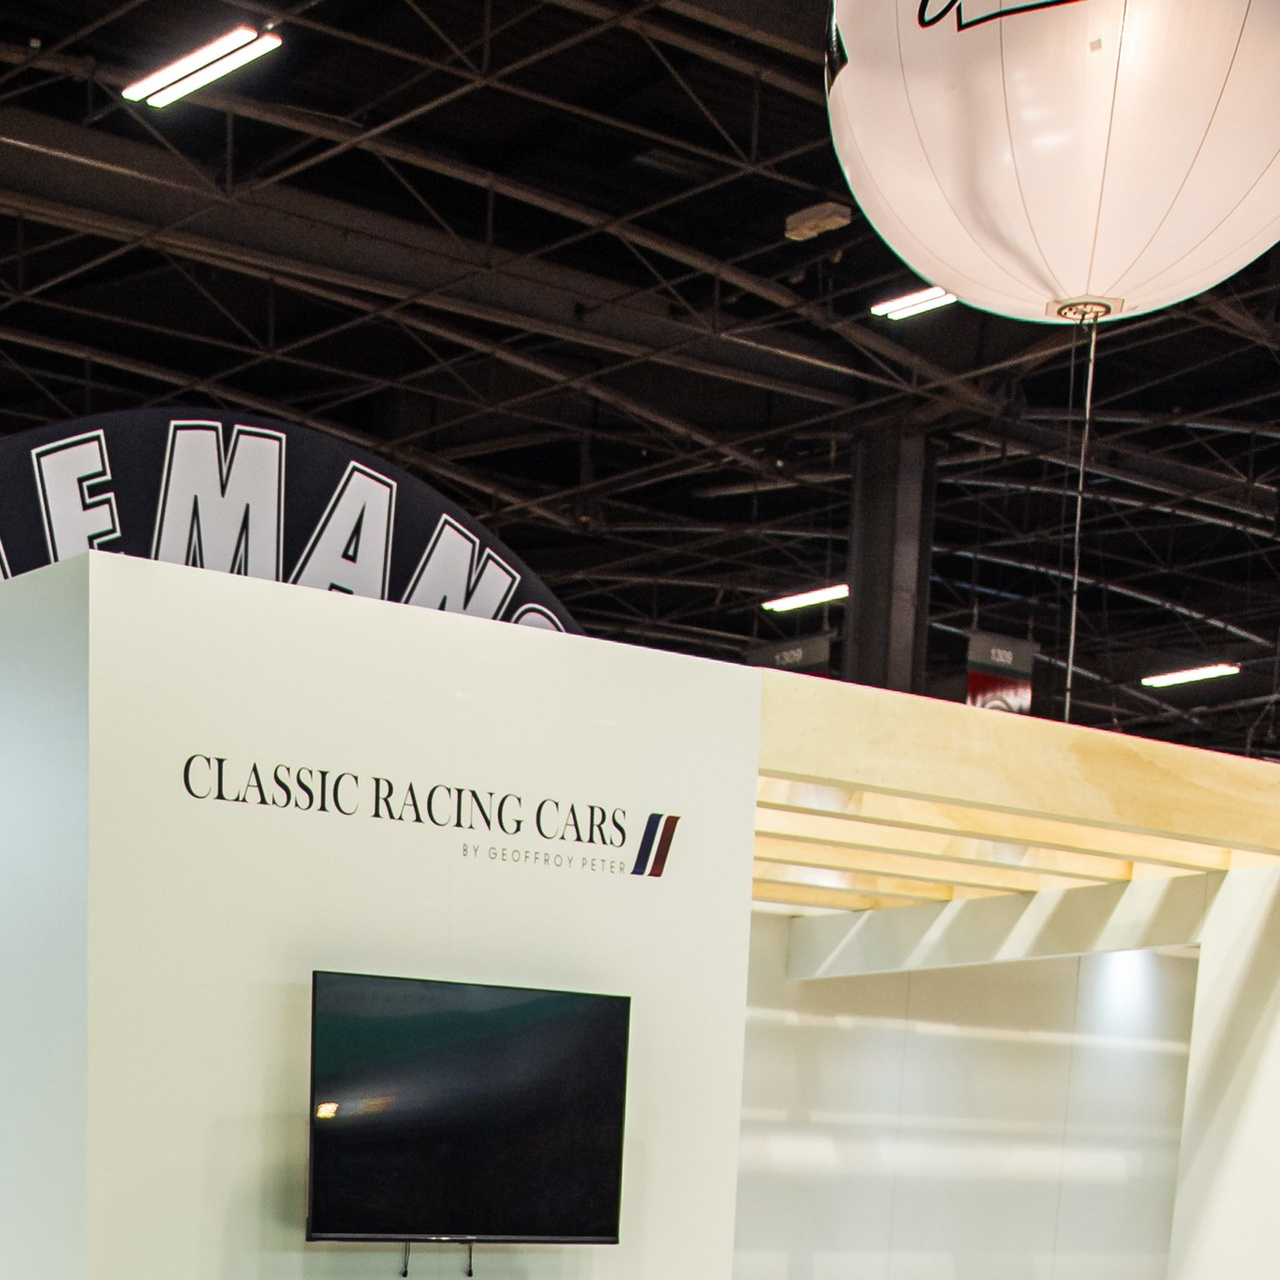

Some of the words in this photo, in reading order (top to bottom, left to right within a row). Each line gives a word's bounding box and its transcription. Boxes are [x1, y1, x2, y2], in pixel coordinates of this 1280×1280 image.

[150, 420, 568, 634] MAN
[183, 753, 360, 816] CLASSIC
[371, 776, 524, 836] RACING
[535, 798, 628, 849] CARS
[462, 844, 480, 858] BY
[488, 847, 575, 869] GEOFFROY
[581, 857, 627, 874] PETER
